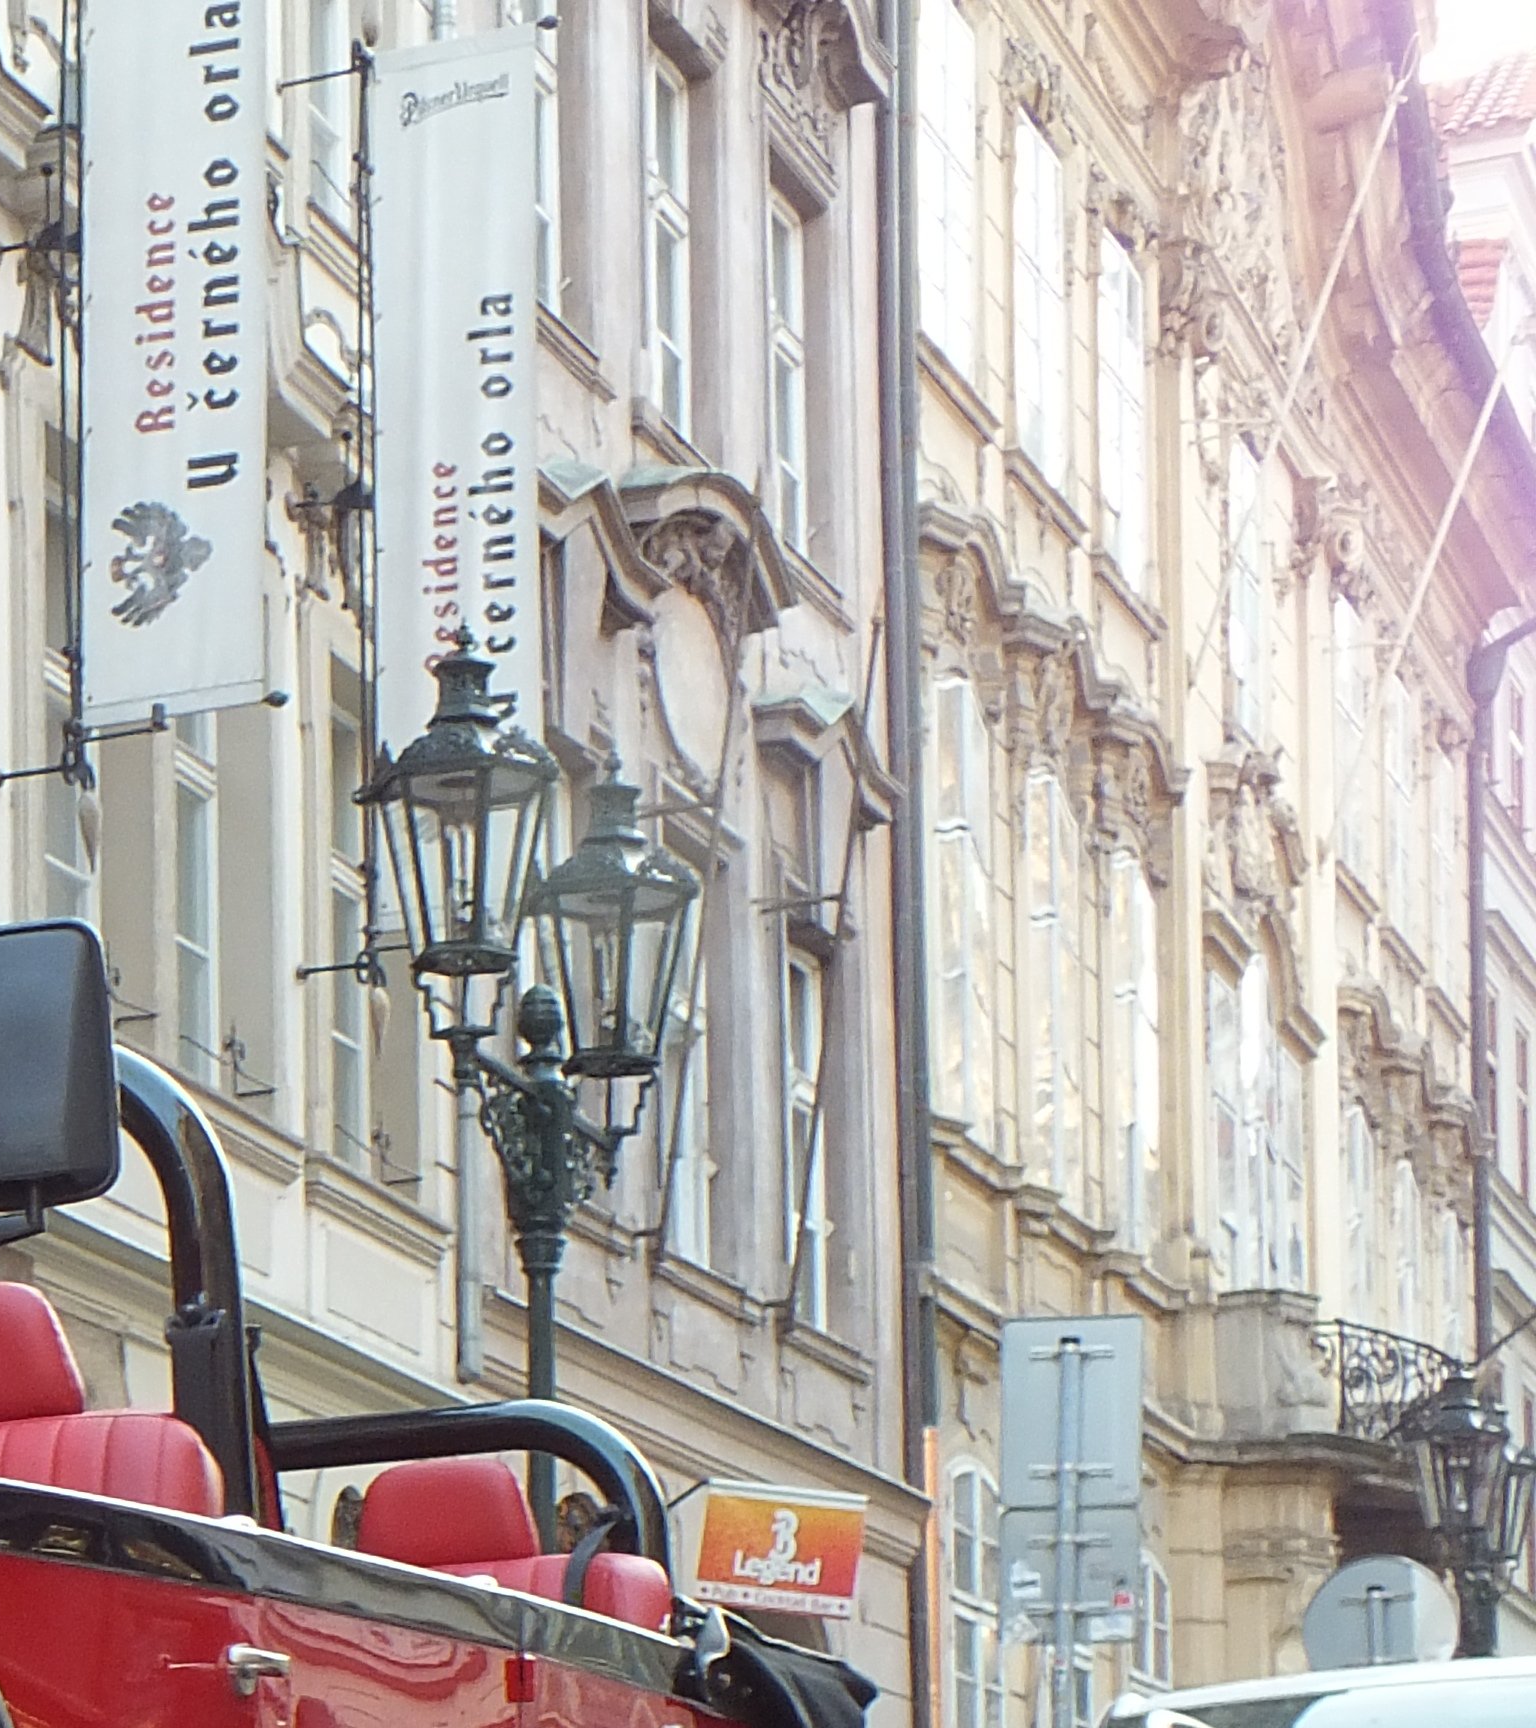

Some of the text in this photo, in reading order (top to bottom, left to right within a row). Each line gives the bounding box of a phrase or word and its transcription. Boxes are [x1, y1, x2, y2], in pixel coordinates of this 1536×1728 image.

[187, 0, 240, 123] orla
[135, 192, 176, 435] Residence
[466, 292, 515, 400] orla
[732, 1549, 822, 1586] Legend
